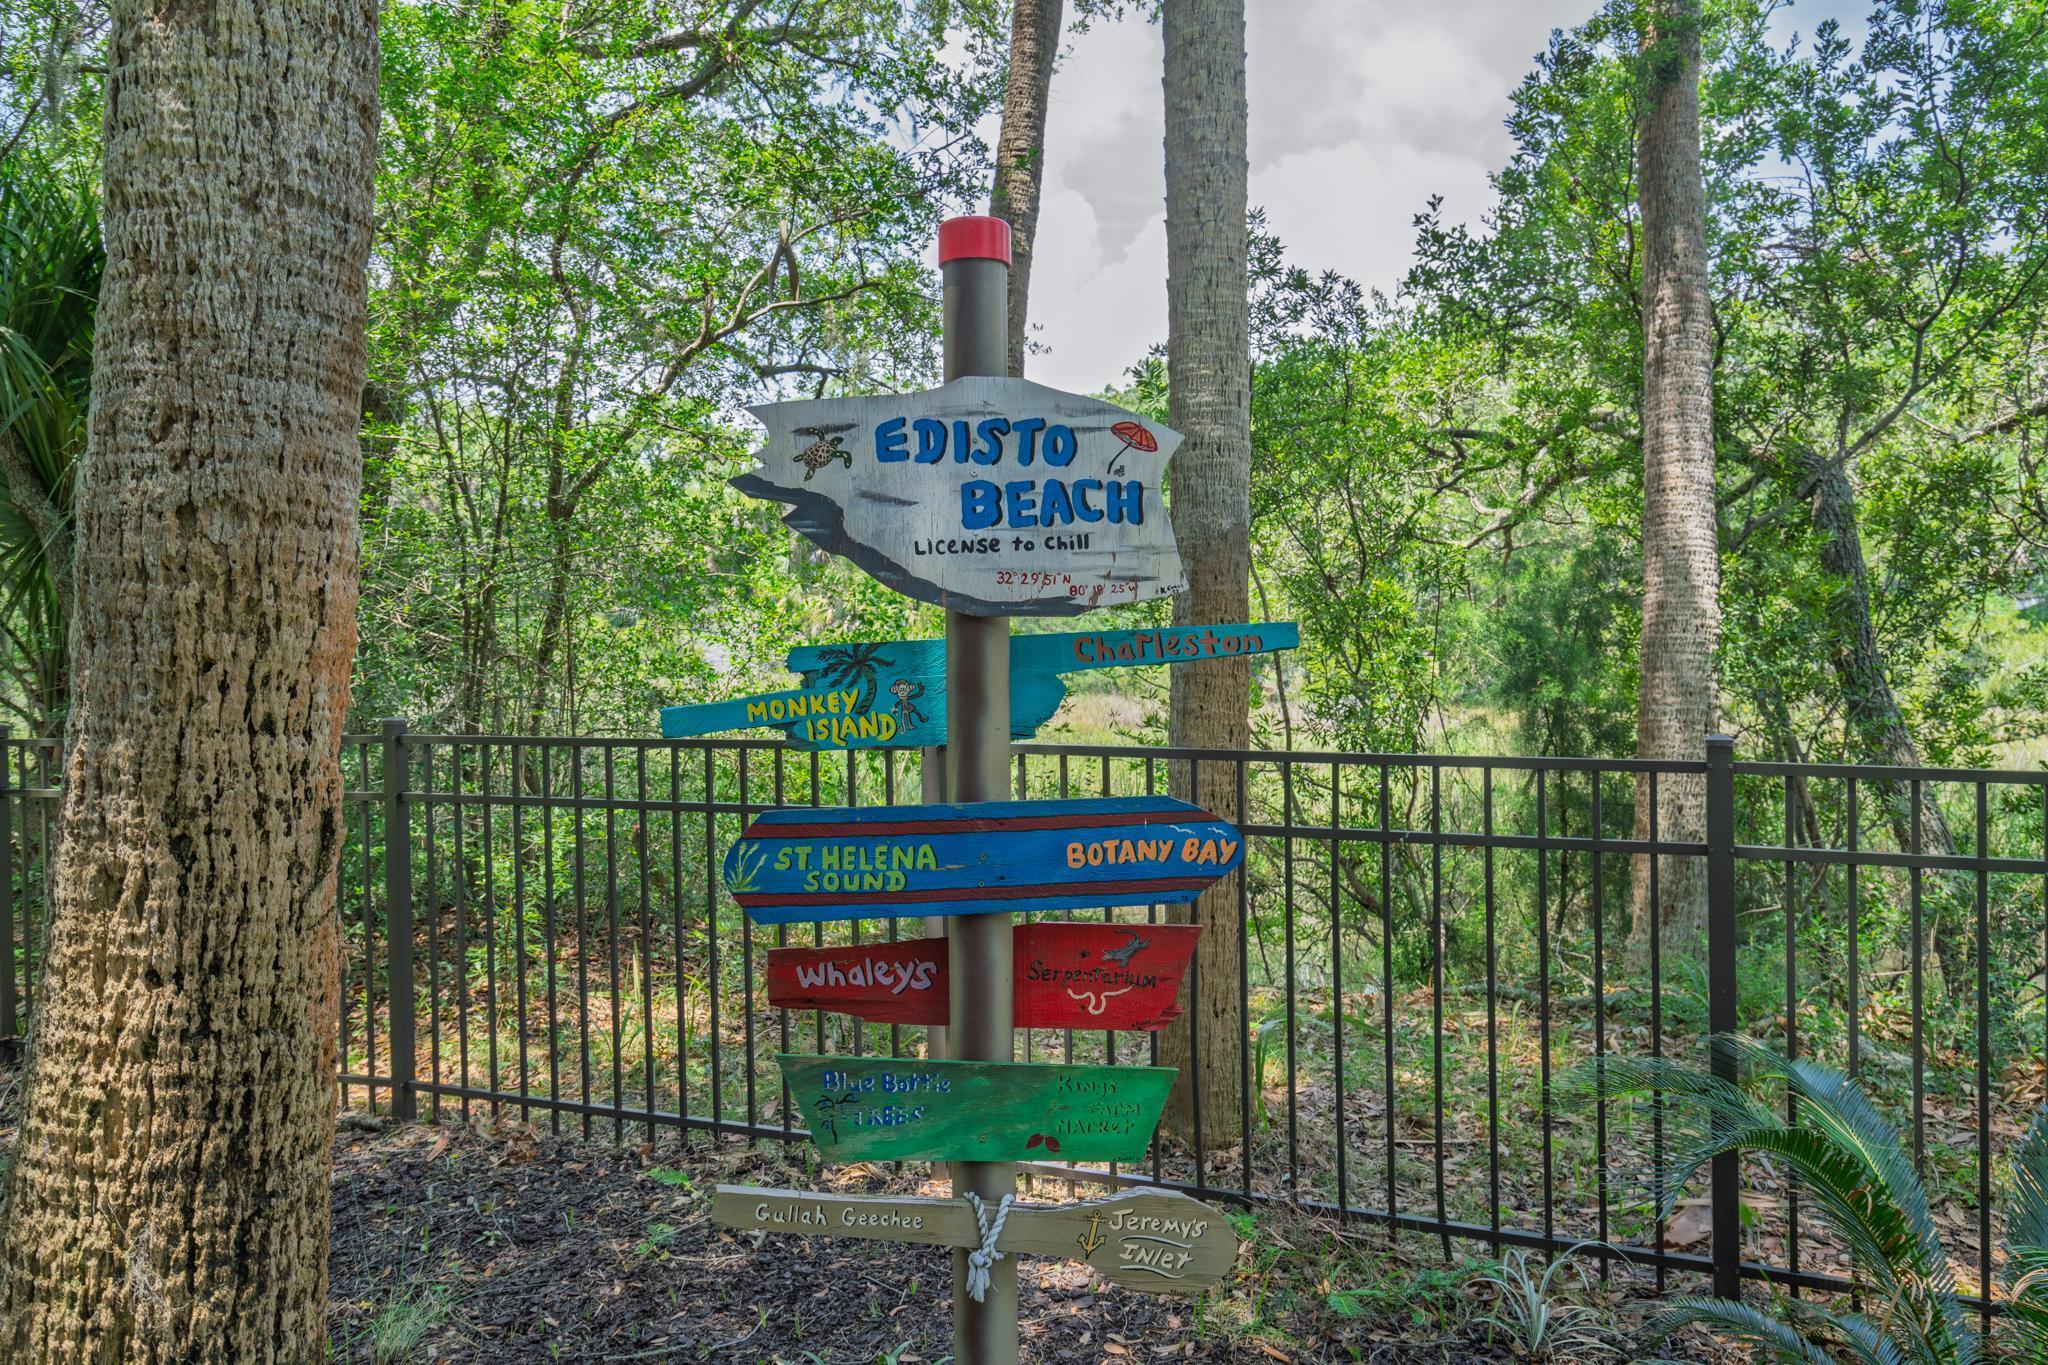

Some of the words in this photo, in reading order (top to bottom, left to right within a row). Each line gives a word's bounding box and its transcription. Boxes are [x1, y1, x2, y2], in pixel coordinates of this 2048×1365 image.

[875, 416, 1078, 467] EDISTO
[960, 478, 1144, 529] BEACH
[1012, 536, 1035, 551] to
[1044, 533, 1090, 550] Chill
[1073, 629, 1264, 664] Charleston
[747, 688, 861, 722] MONKEY
[807, 711, 899, 746] ISLAND
[774, 846, 813, 870] ST.
[822, 843, 938, 870] HELENA
[1066, 839, 1175, 869] BOTANY
[1181, 837, 1238, 866] BAY
[803, 870, 907, 892] SOUND
[796, 957, 938, 995] Whaley's
[823, 1071, 875, 1092] Blue
[755, 1203, 828, 1226] Gullah
[842, 1207, 923, 1229] Geechee
